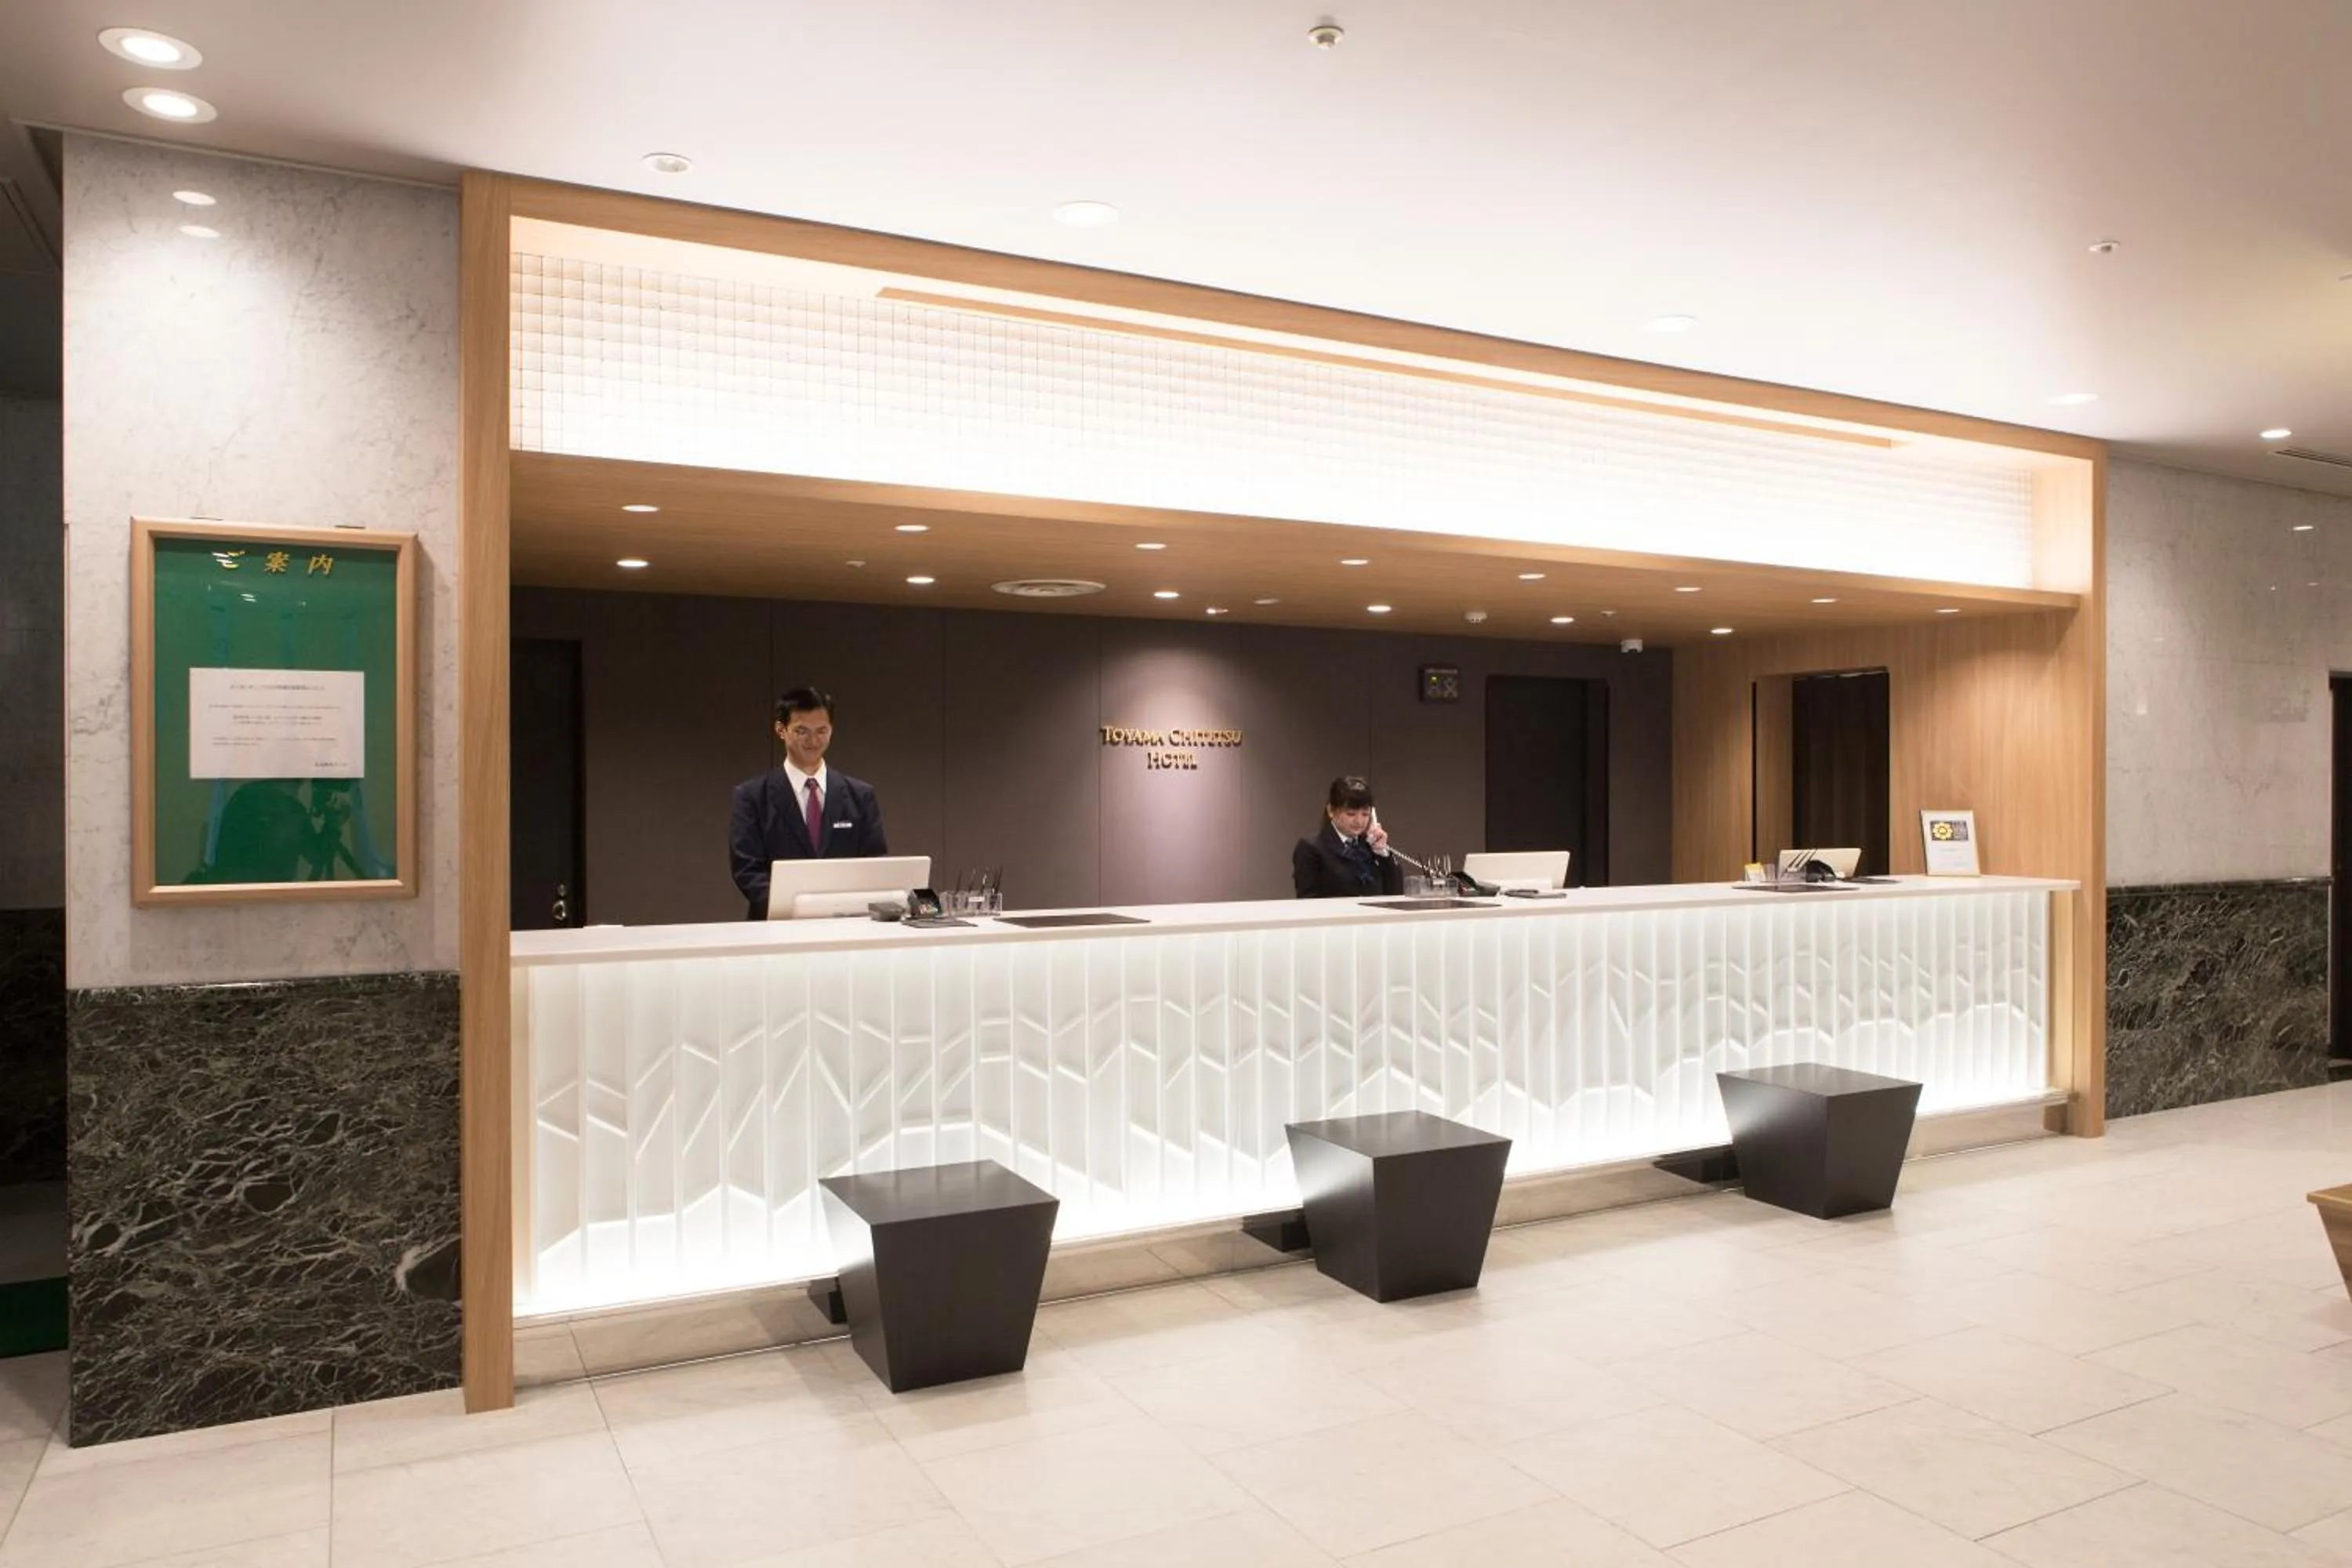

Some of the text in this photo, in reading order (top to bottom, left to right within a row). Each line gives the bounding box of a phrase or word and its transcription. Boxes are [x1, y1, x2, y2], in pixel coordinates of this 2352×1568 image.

[212, 550, 334, 575] ご案内
[1102, 726, 1165, 746] TOYAMA
[1148, 751, 1197, 769] HOTEL
